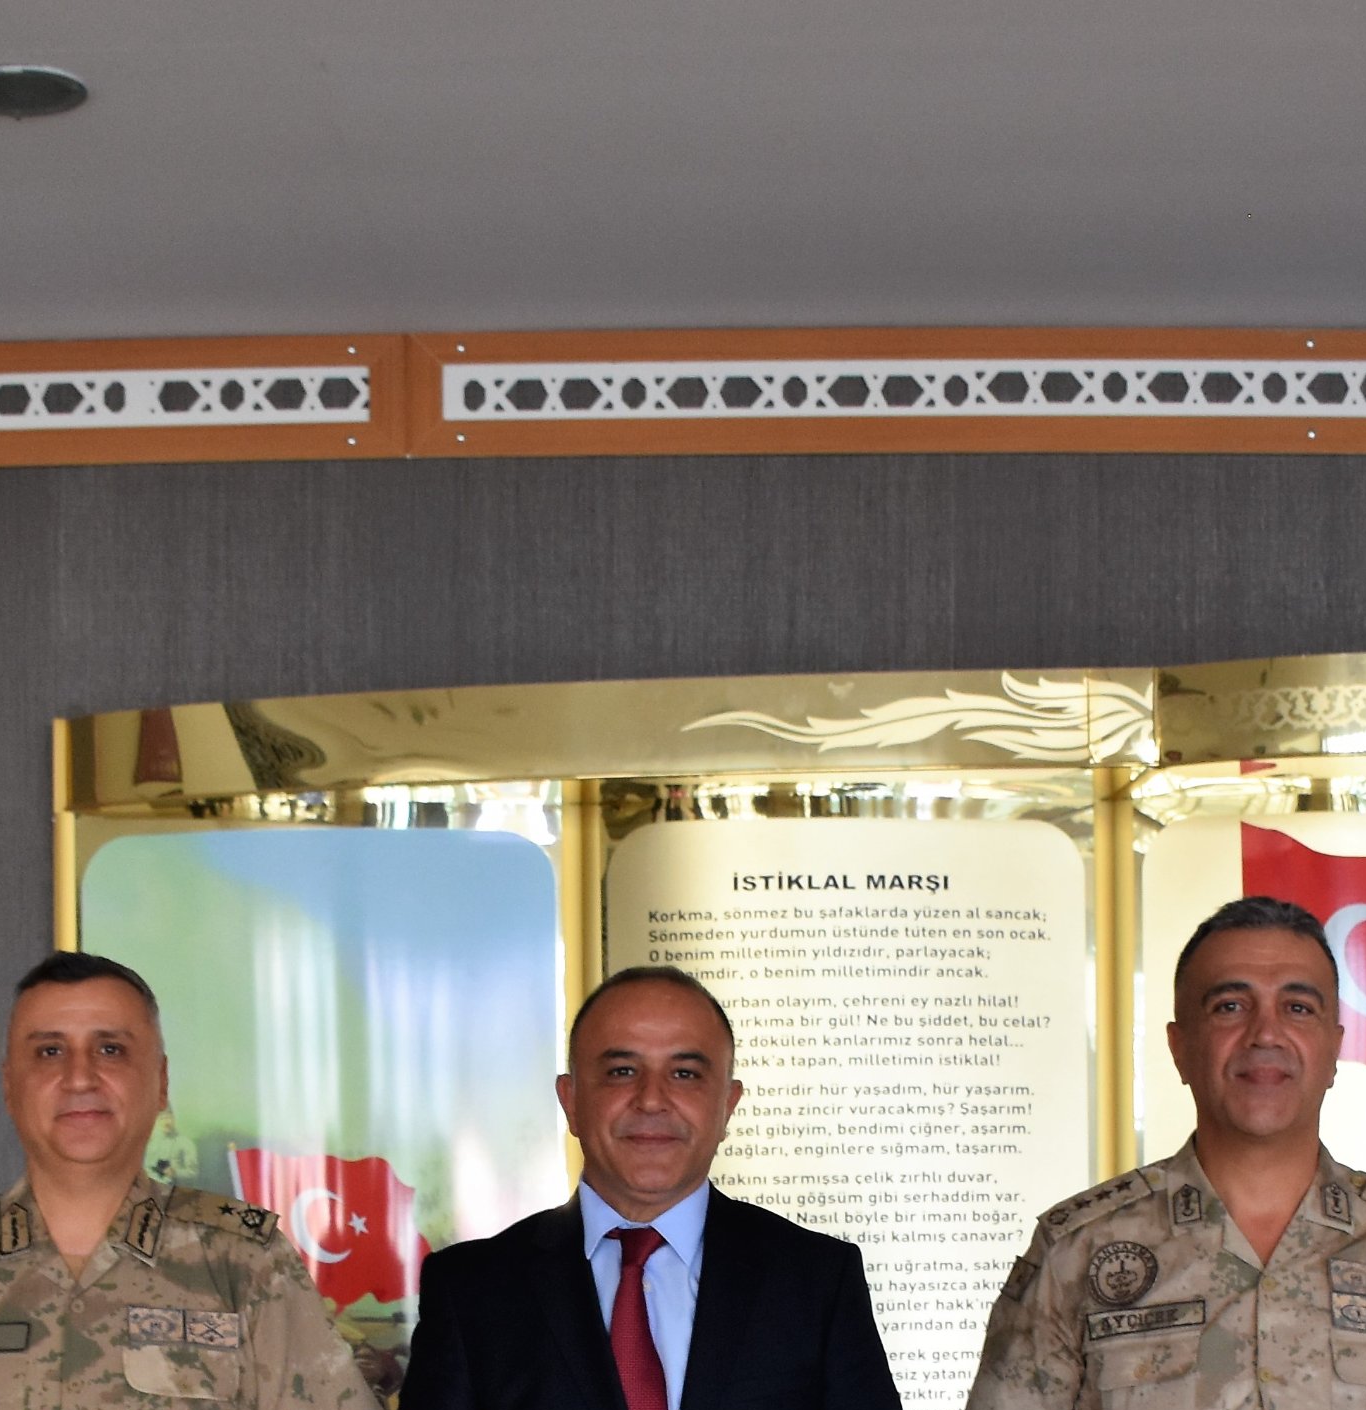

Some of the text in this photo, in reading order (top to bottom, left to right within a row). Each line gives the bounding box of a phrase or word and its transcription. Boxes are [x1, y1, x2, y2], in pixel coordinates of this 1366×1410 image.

[733, 870, 948, 894] İSTİKLAL MARŞI
[648, 909, 717, 923] Korkma,
[793, 906, 813, 918] bu
[818, 906, 907, 919] şafaklarda
[912, 906, 960, 921] yüzen
[965, 906, 980, 918] al
[985, 908, 1046, 922] sancak;
[648, 925, 1050, 942] Sönmeden yurdumun üstünde en son ocak.
[664, 949, 714, 961] benim
[719, 946, 806, 958] milletimin
[811, 945, 890, 960] yıldızıdır,
[895, 945, 990, 960] parlayacak;
[764, 965, 987, 978] benim milletimindir ancak.
[775, 995, 837, 1009] olayım,
[842, 994, 905, 1008] çehreni
[910, 996, 929, 1009] ey
[934, 994, 972, 1006] nazlı
[977, 994, 1018, 1007] hilal!
[740, 1015, 794, 1027] ırkıma
[800, 1014, 822, 1026] bir
[828, 1014, 860, 1029] gül!
[866, 1014, 888, 1026] Ne
[893, 1014, 913, 1026] bu
[918, 1014, 973, 1028] şiddet,
[978, 1015, 997, 1027] bu
[822, 1034, 911, 1046] kanlarımız
[916, 1036, 963, 1046] sonra
[790, 1055, 842, 1069] tapan,
[848, 1053, 933, 1065] milletimin
[757, 1082, 1034, 1097] beridir hür yaşadım, hür yaşarım.
[752, 1104, 792, 1116] bana
[848, 1102, 955, 1116] vuracakmış?
[736, 1124, 760, 1136] sel
[765, 1123, 831, 1139] gibiyim,
[837, 1122, 903, 1134] bendimi
[970, 1124, 1030, 1135] aşarım.
[724, 1142, 1021, 1159] dağları, enginlere sığmam, taşarım.
[772, 1174, 849, 1185] sarmışsa
[854, 1171, 894, 1184] çelik
[899, 1171, 941, 1183] zırhlı
[947, 1170, 997, 1184] duvar,
[755, 1192, 791, 1205] dolu
[868, 1191, 898, 1206] gibi
[903, 1190, 990, 1203] serhaddim
[995, 1192, 1025, 1202] var.
[796, 1209, 1022, 1225] Nasıl böyle bir boğar,
[857, 1229, 1023, 1245] dişi kalmış canavar?
[894, 1259, 968, 1274] uğratma,
[888, 1279, 967, 1294] hayasızca
[876, 1299, 929, 1313] günler
[881, 1317, 976, 1333] yarından da
